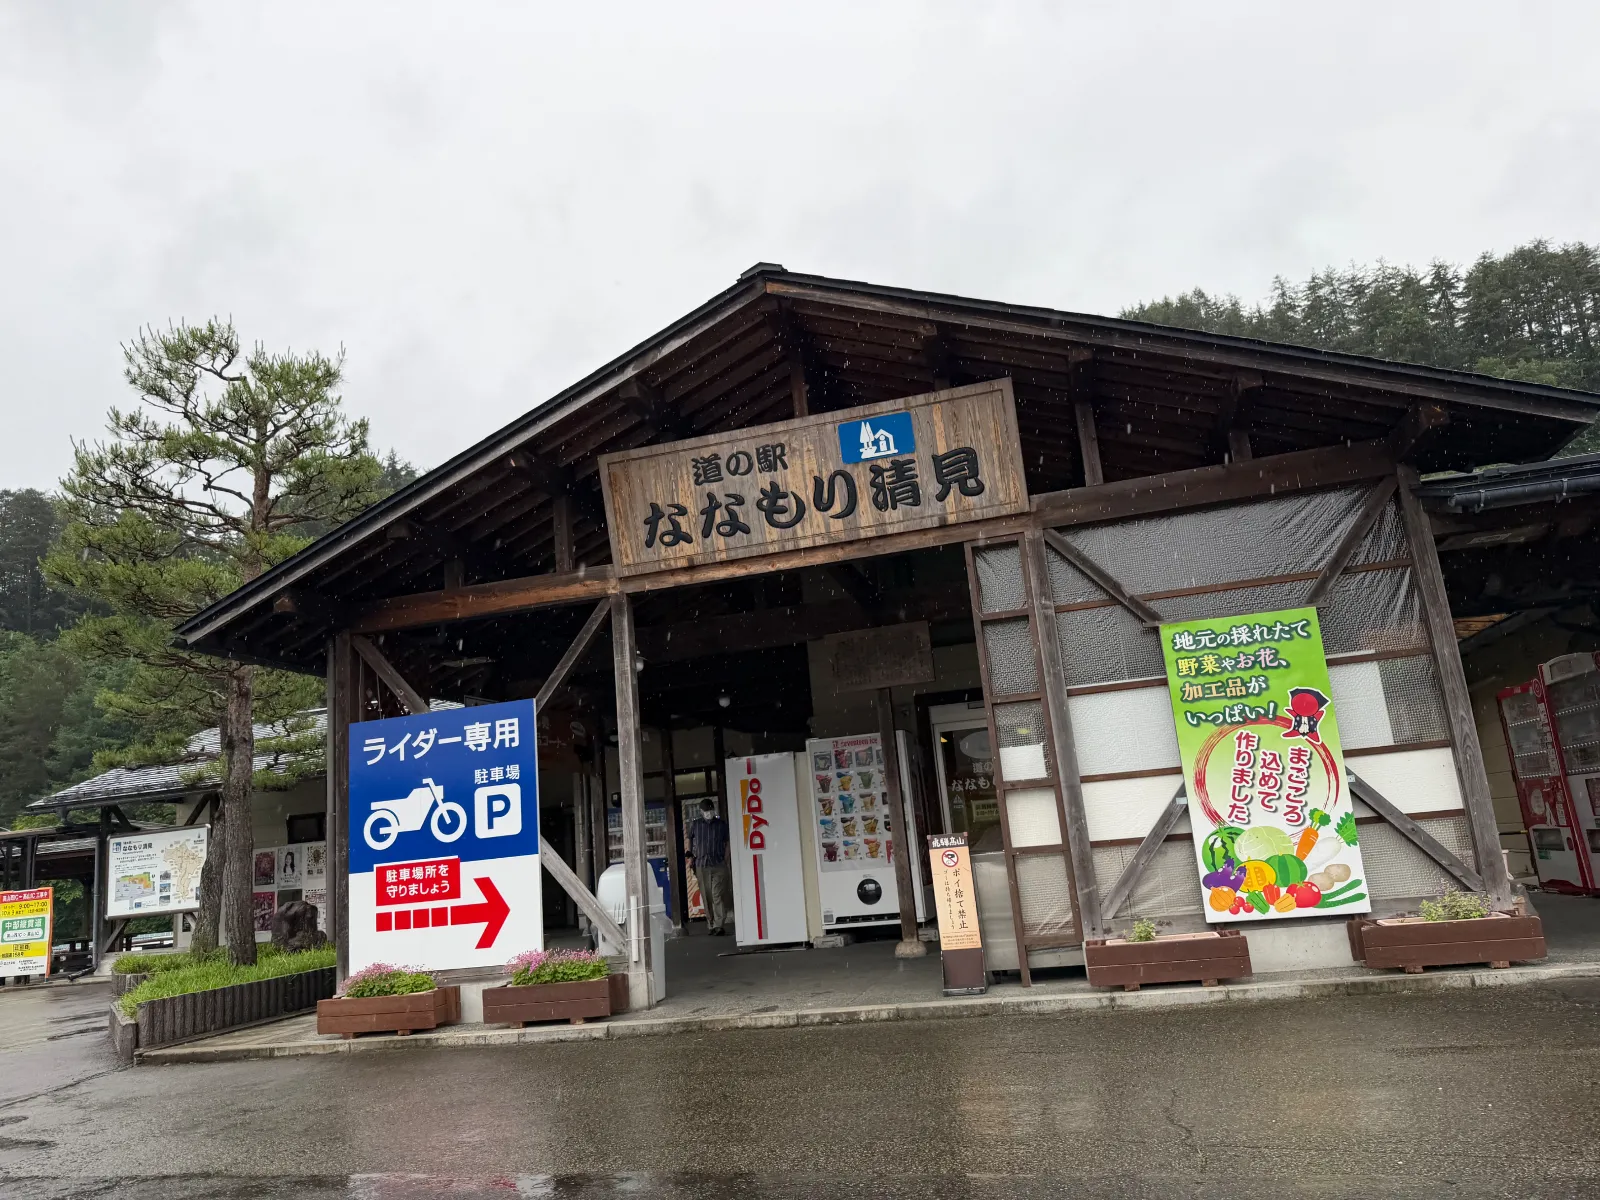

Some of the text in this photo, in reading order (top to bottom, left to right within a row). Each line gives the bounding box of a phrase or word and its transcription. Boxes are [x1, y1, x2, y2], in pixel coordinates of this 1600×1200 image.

[692, 442, 788, 486] 道の駅
[644, 446, 985, 548] ななもり清見
[1173, 620, 1310, 649] 地元の採れたて
[1177, 649, 1291, 679] 野菜やお花、
[1181, 676, 1268, 702] 加工品が
[1185, 703, 1276, 726] いっぱい!
[363, 718, 520, 765] ライダー専用
[474, 764, 521, 785] 駐車場
[951, 776, 996, 792] ななも
[1228, 732, 1257, 825] 作りました
[1257, 751, 1284, 812] 込めて
[1283, 745, 1310, 825] まごころ
[487, 794, 511, 829] P
[747, 778, 770, 852] DyDo
[122, 843, 153, 851] ななもり清見
[932, 836, 965, 849] 飛騨高山
[386, 864, 450, 883] 駐車場所を
[386, 880, 451, 899] 守りましょう
[952, 868, 969, 930] ポイ捨て禁止
[5, 918, 42, 930] 中部縦貫道
